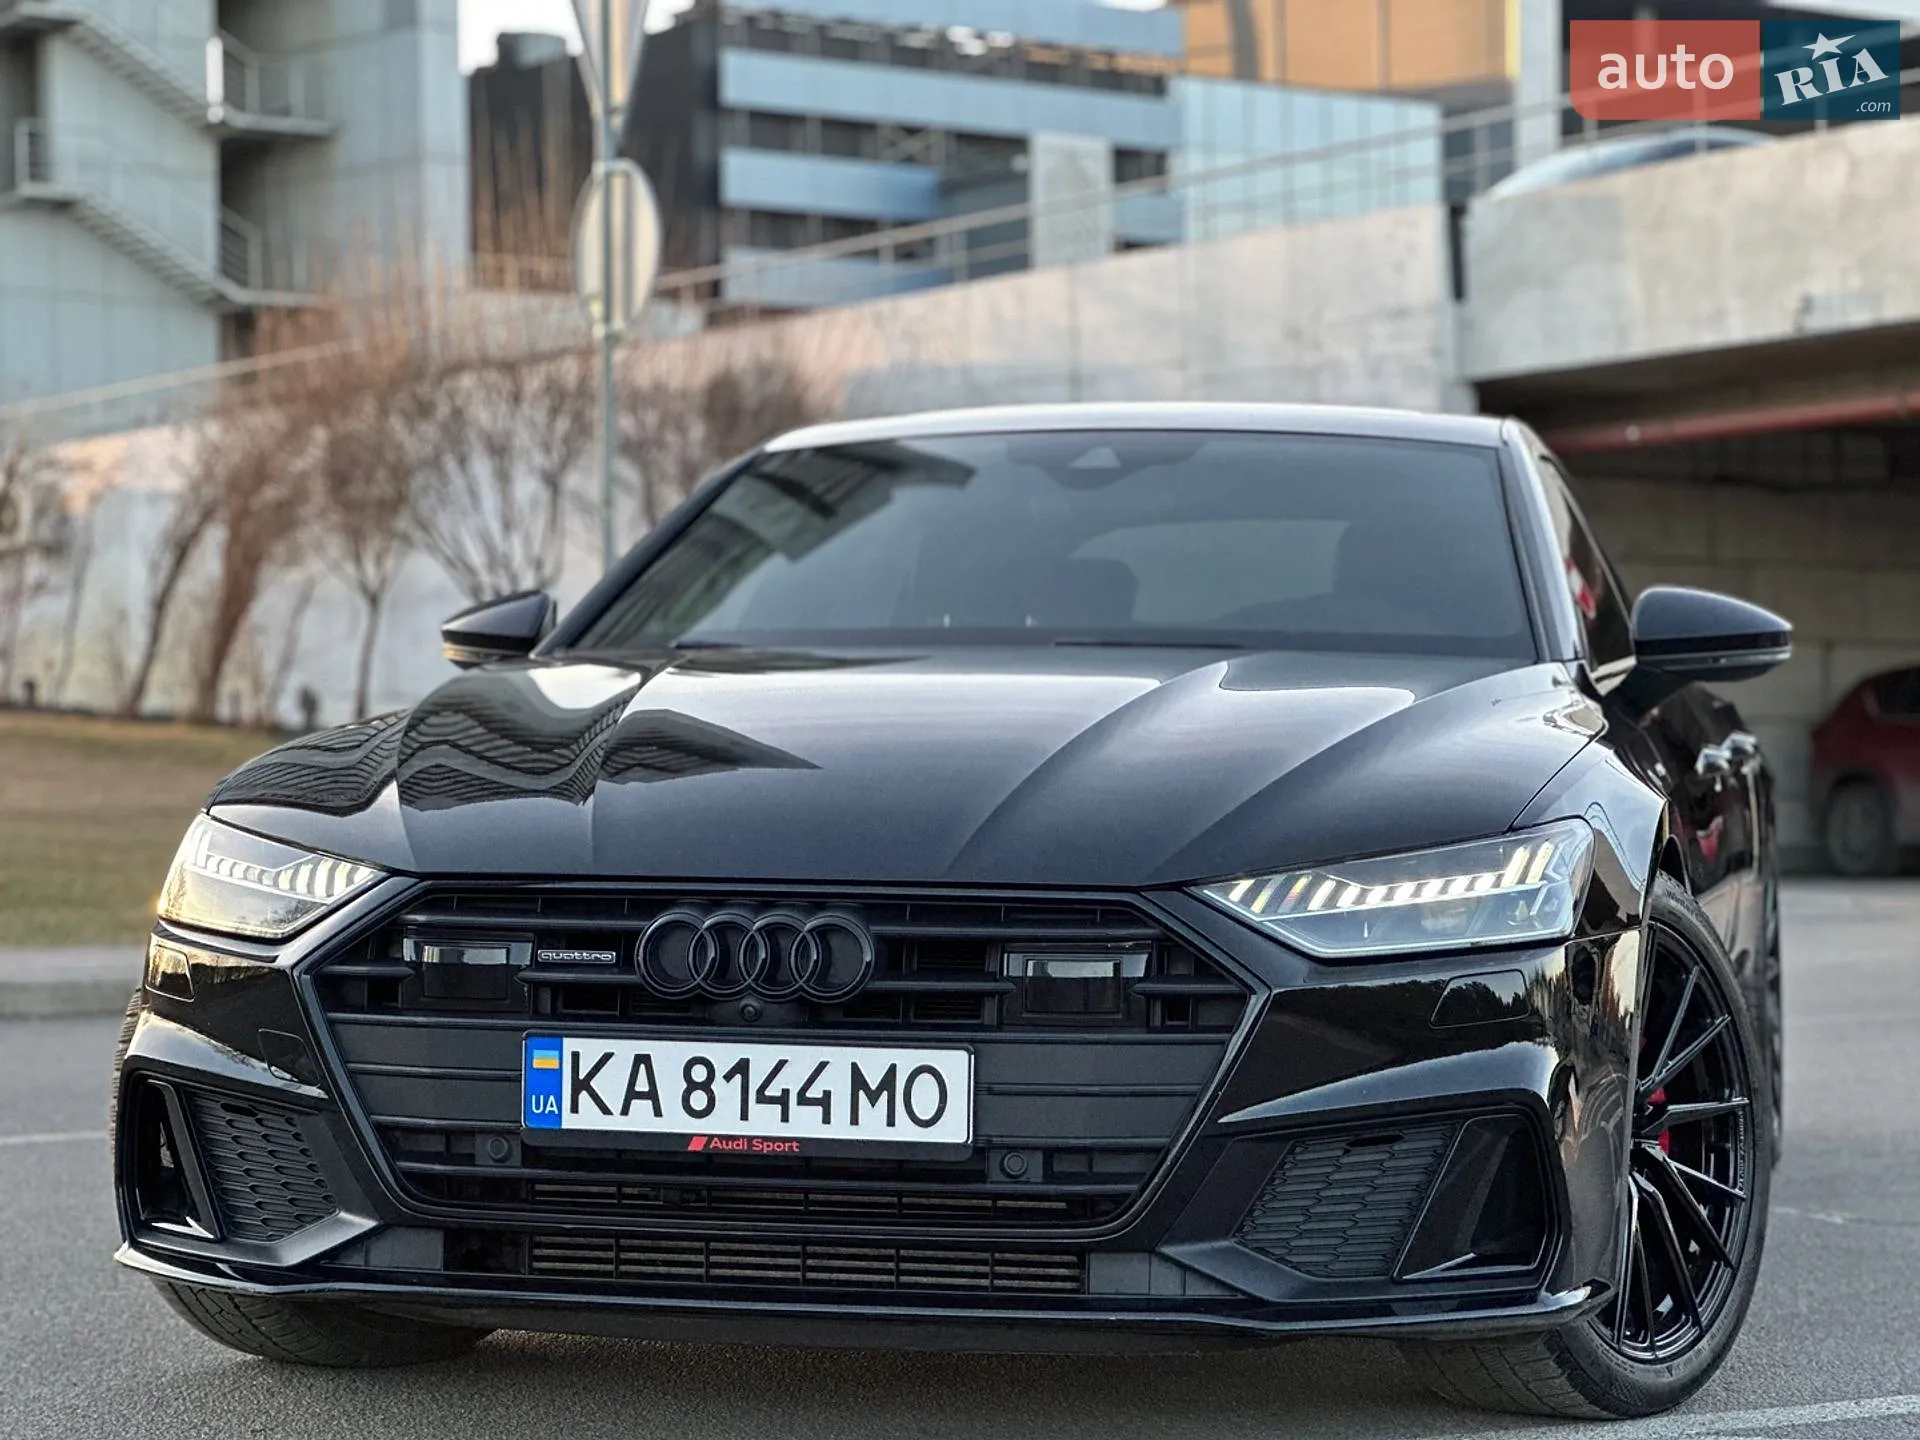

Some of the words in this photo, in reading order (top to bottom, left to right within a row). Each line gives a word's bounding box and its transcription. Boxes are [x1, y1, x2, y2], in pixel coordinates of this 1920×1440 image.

[541, 951, 612, 961] quattro
[570, 1050, 664, 1118] KA
[681, 1055, 833, 1125] 8144
[850, 1061, 948, 1128] MO
[531, 1094, 559, 1115] UA
[709, 1136, 748, 1151] Audi
[752, 1138, 800, 1154] Sport
